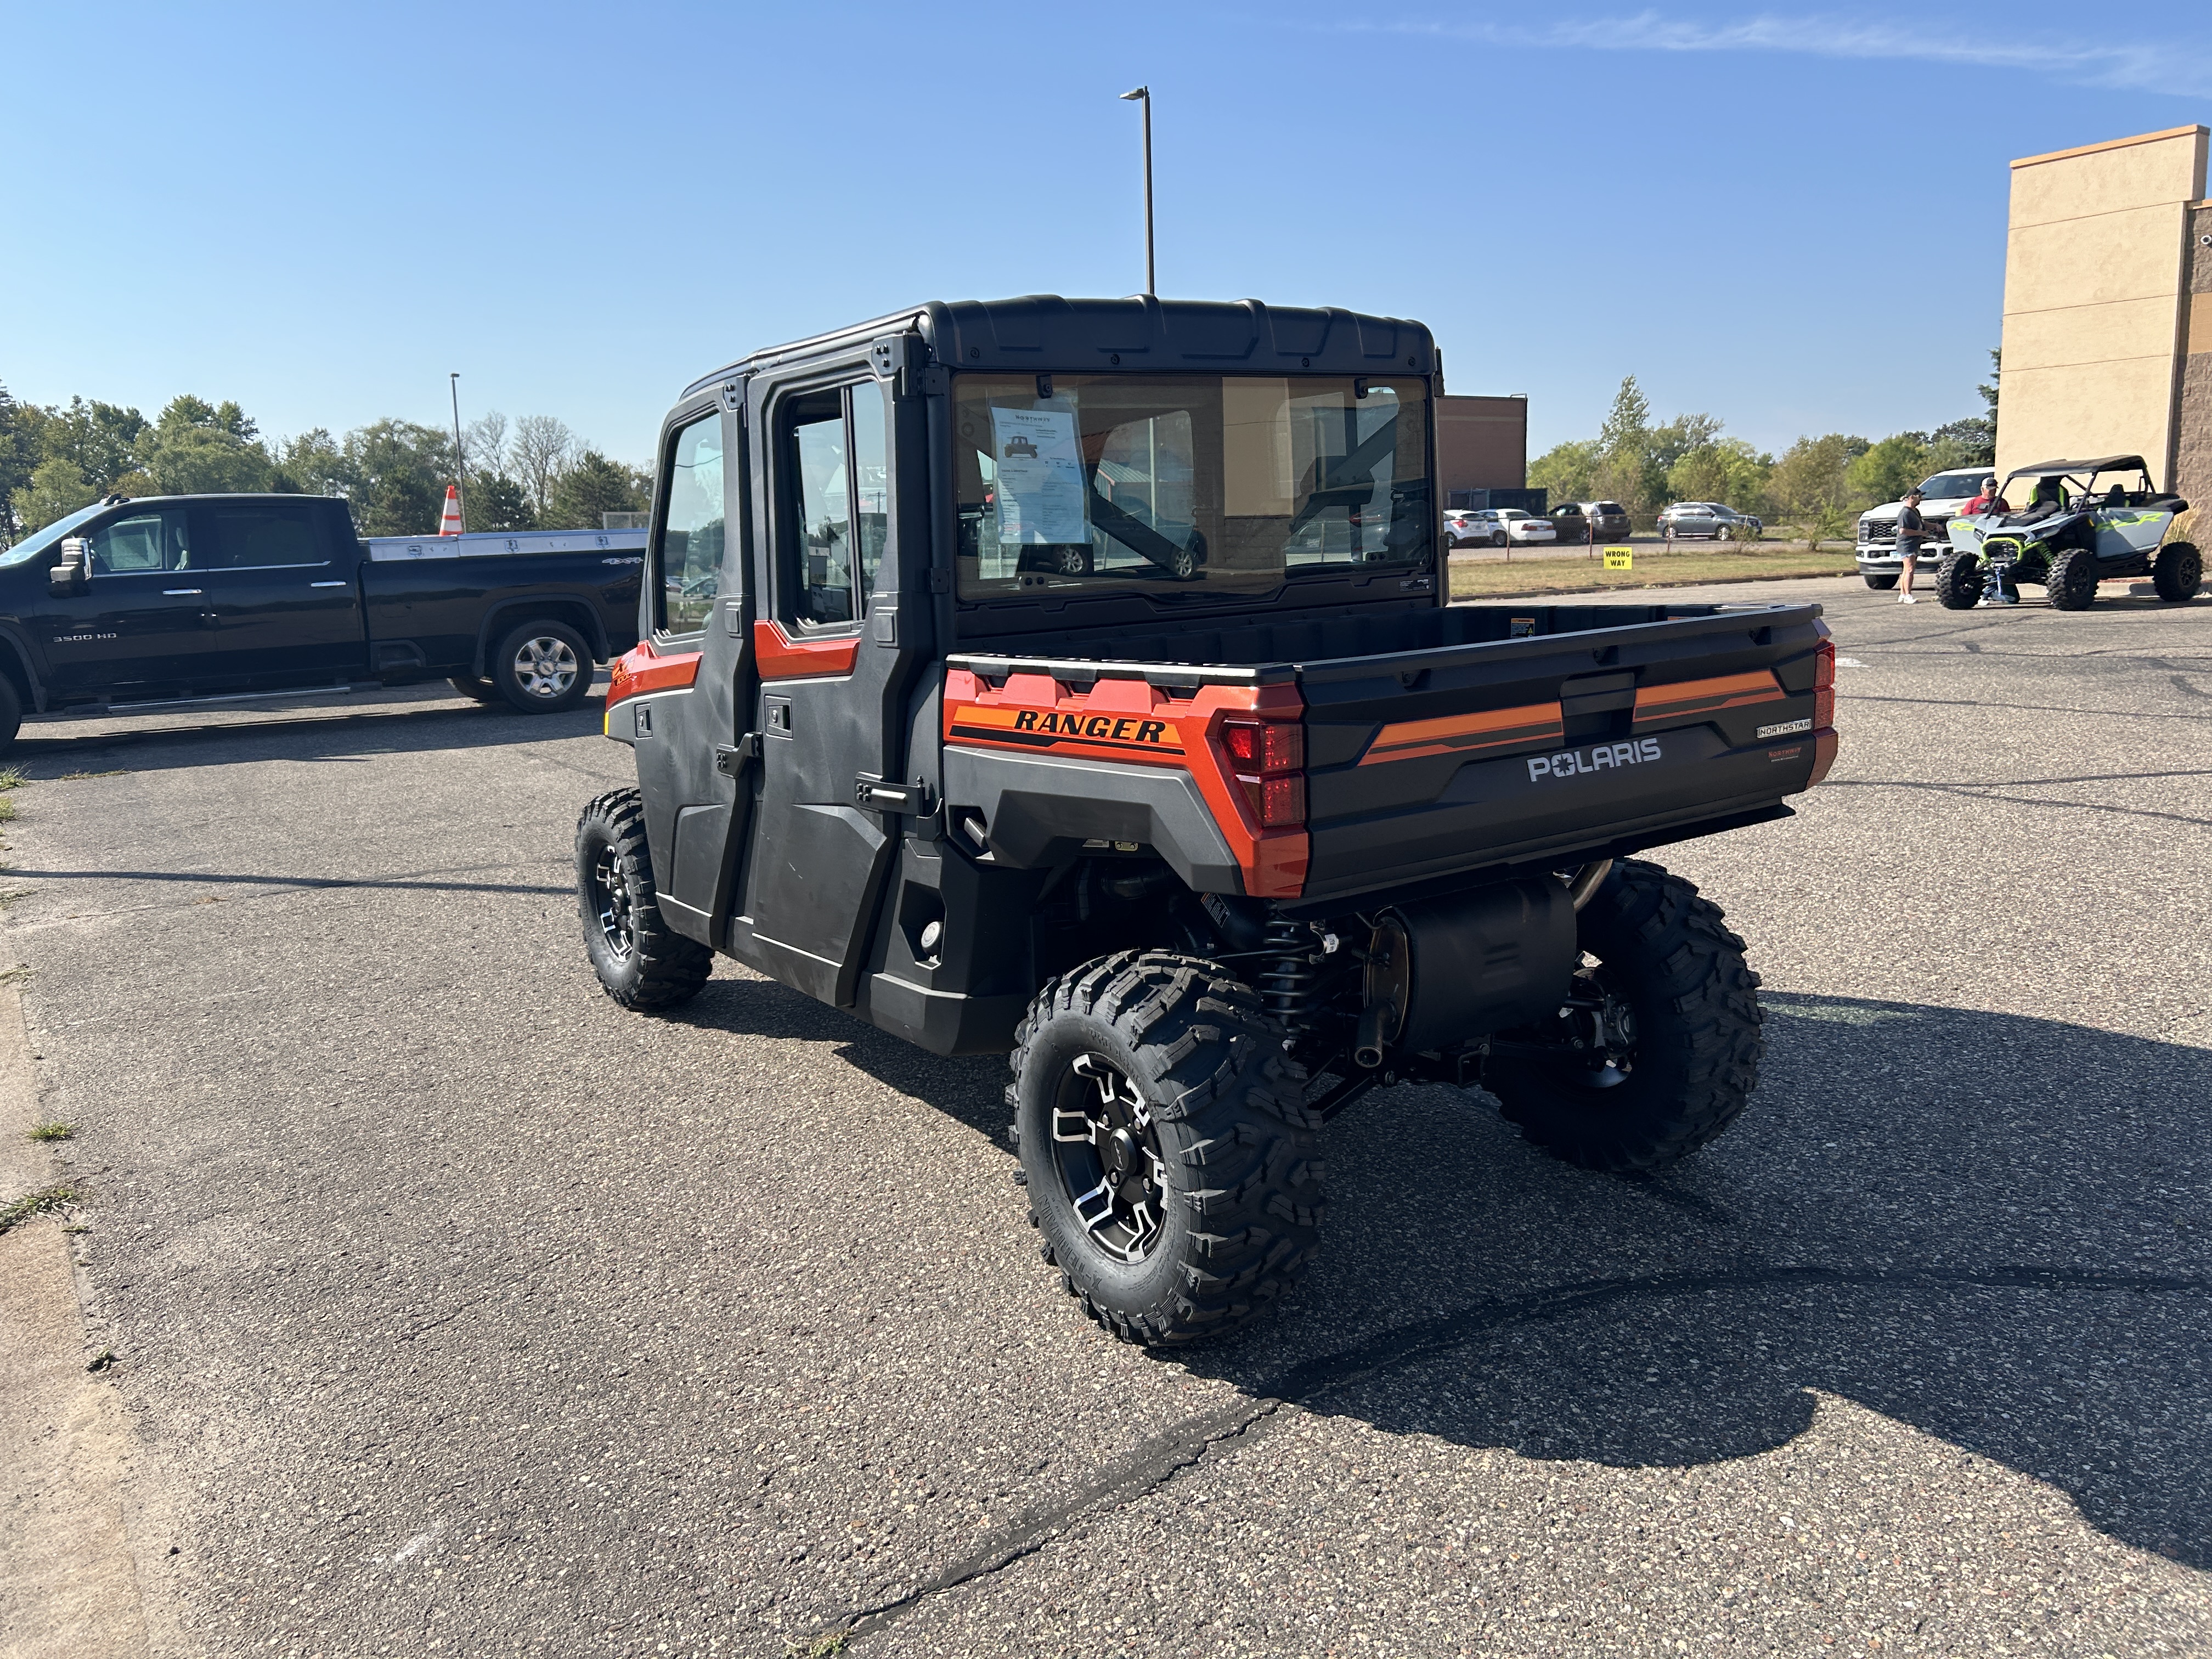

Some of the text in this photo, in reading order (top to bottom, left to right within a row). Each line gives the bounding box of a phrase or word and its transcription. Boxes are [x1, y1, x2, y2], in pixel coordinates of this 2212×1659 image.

[53, 634, 92, 642] 3500
[1014, 710, 1166, 743] RANGER
[1760, 721, 1809, 736] NORTHSTAR
[1527, 737, 1661, 782] POLARIS
